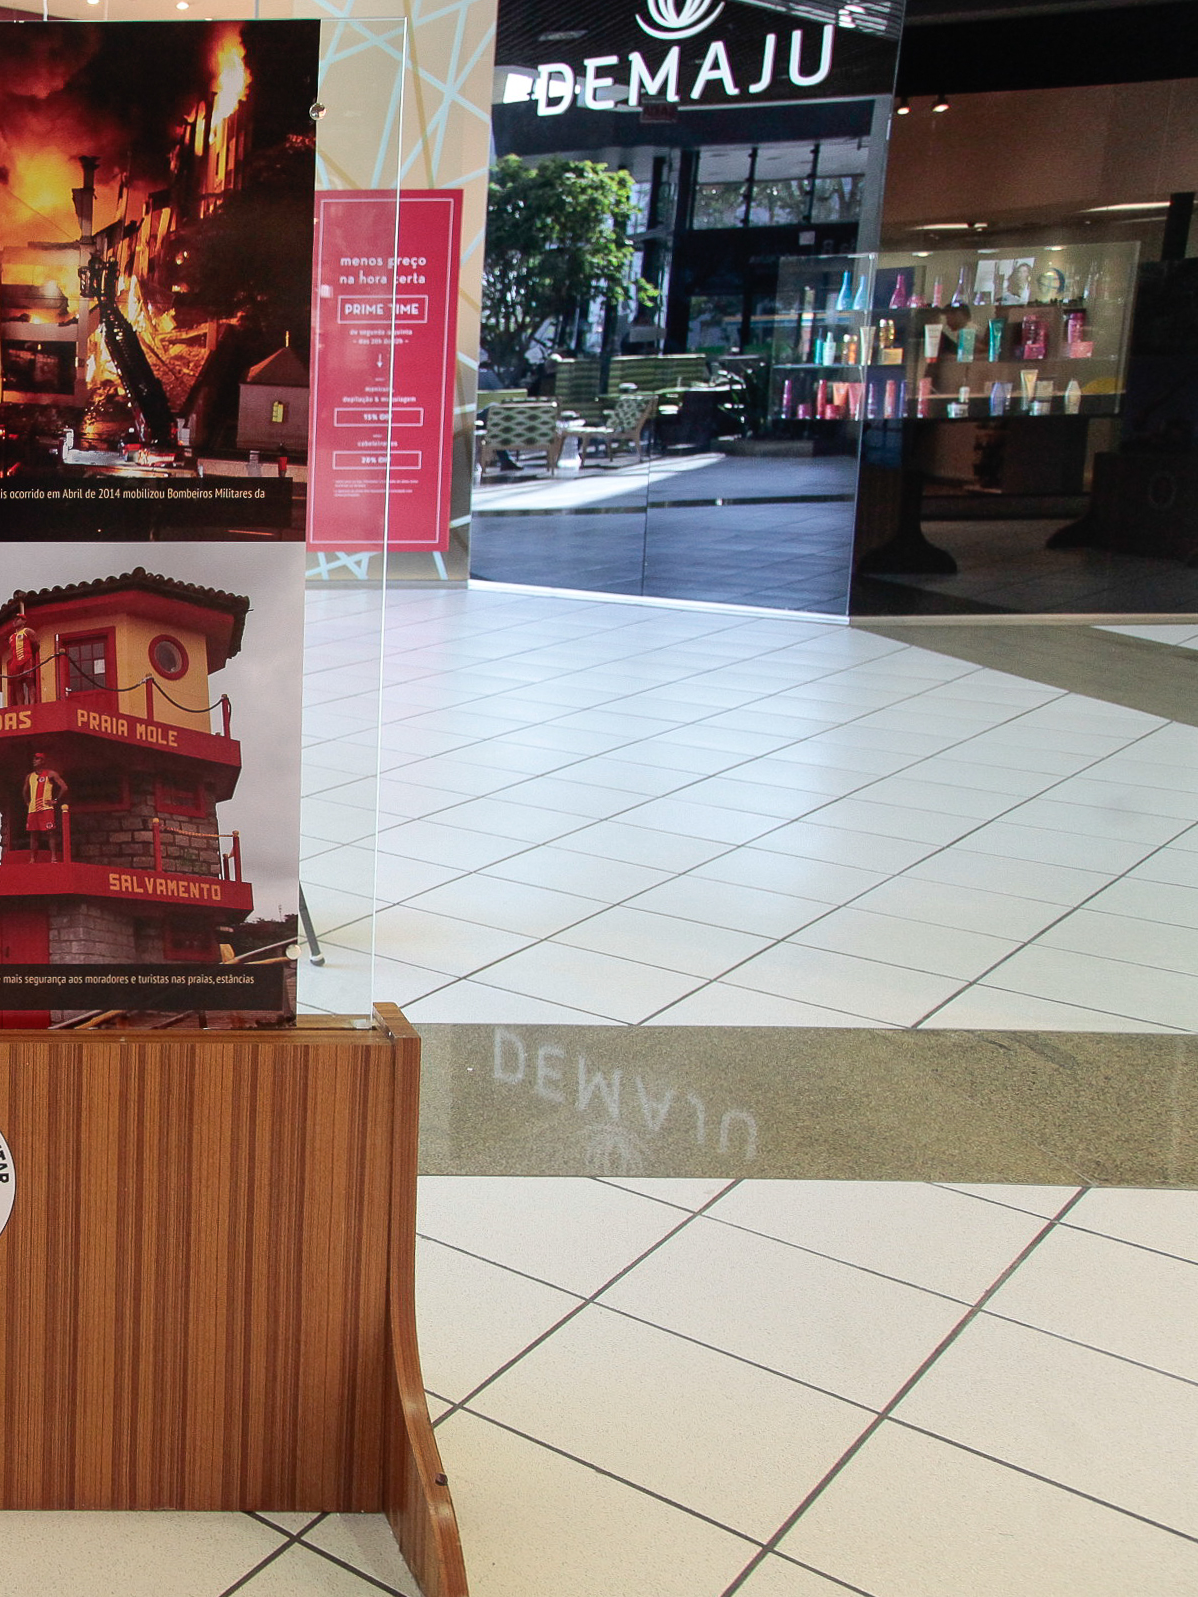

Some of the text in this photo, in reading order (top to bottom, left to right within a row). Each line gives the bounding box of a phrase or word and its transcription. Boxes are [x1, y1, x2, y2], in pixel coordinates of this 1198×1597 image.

[537, 24, 835, 117] DEMAJU
[340, 257, 383, 266] menos
[340, 276, 355, 284] na
[359, 270, 387, 284] hora
[344, 303, 384, 315] PRIME
[9, 488, 45, 499] ocorrido
[47, 490, 60, 499] em
[62, 488, 82, 499] Abril
[85, 488, 96, 499] de
[98, 489, 120, 499] 2014
[123, 488, 165, 499] mobilizou
[167, 488, 213, 499] Bombeiros
[214, 488, 252, 499] Militares
[254, 488, 265, 499] da
[77, 709, 178, 747] PRAIA MOLE
[108, 873, 221, 901] SALVAMENTO
[3, 974, 23, 984] mais
[24, 975, 66, 986] segurança
[68, 976, 83, 984] aos
[84, 974, 129, 984] moradores
[130, 976, 136, 984] e
[138, 974, 169, 984] turistas
[171, 976, 186, 984] nas
[187, 974, 215, 986] praias,
[216, 974, 255, 984] estâncias
